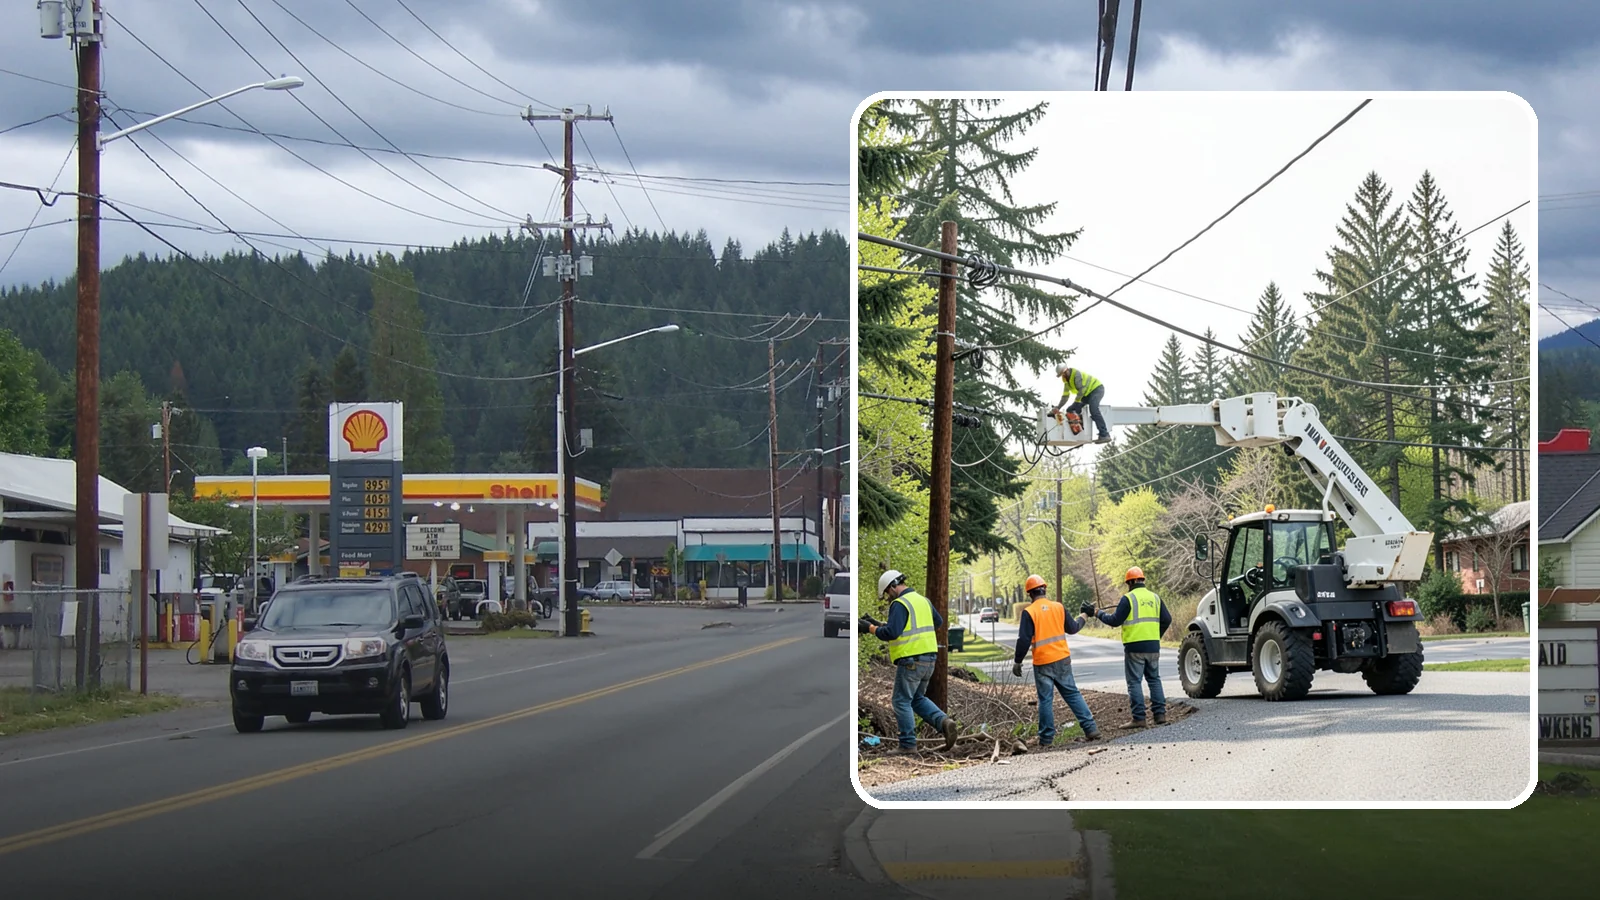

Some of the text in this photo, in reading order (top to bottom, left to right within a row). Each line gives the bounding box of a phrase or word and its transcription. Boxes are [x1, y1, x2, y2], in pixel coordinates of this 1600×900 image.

[490, 484, 547, 499] Shell
[1538, 642, 1567, 665] AID
[1539, 716, 1592, 738] WKENS
